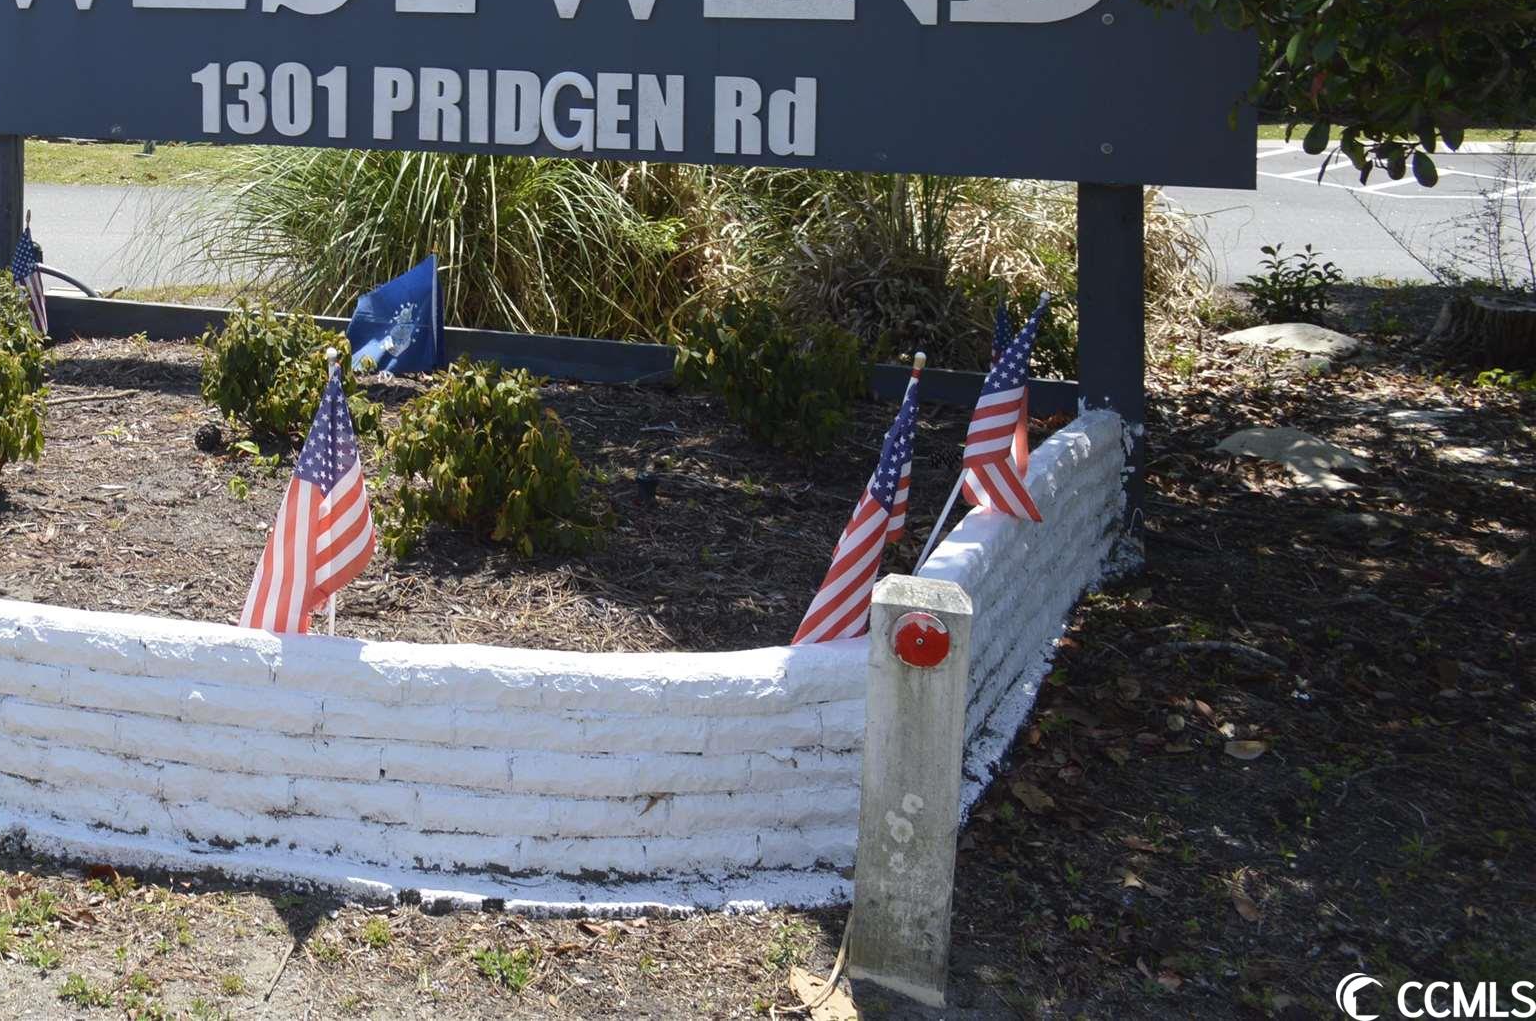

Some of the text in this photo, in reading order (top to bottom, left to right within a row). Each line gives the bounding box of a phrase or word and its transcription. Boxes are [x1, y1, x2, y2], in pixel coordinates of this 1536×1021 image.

[192, 63, 816, 155] 1301 PRIDGEN Rd
